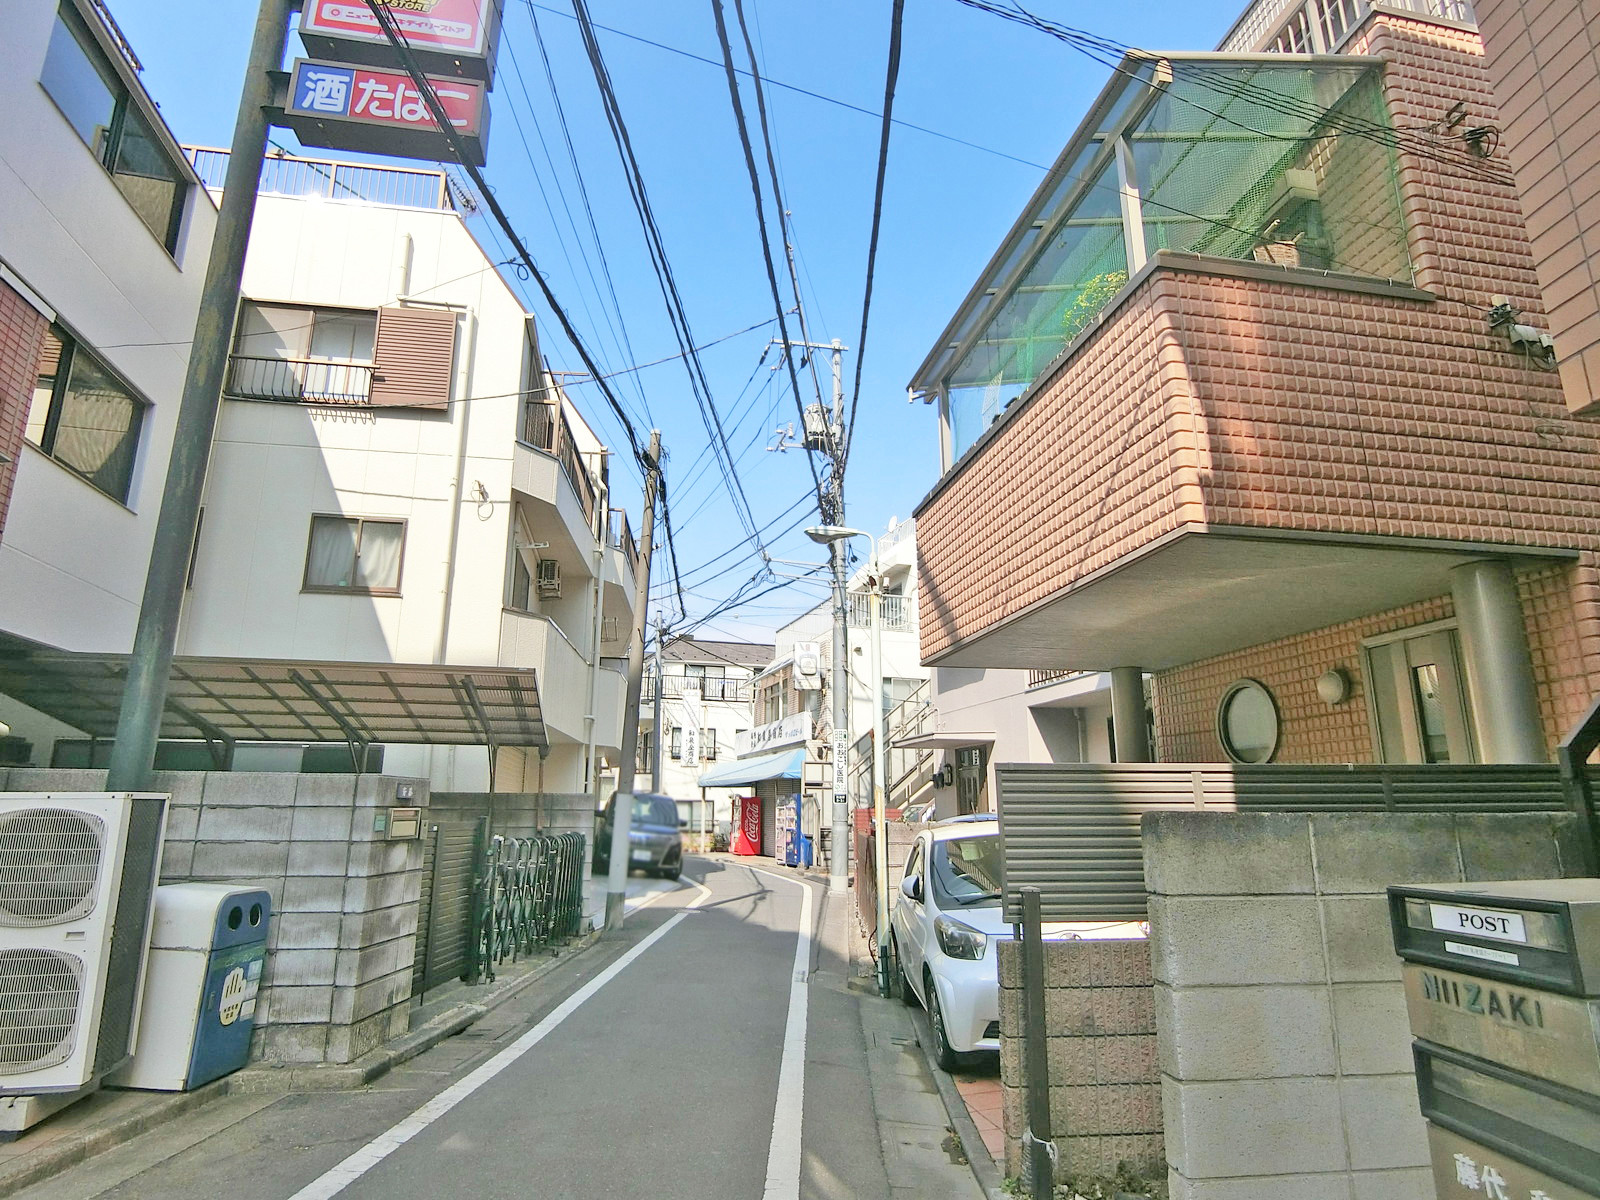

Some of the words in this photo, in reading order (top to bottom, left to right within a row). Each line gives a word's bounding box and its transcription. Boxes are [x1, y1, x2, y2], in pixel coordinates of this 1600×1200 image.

[390, 0, 430, 12] STORE
[301, 70, 351, 112] 酒
[355, 78, 470, 127] たばこ
[836, 743, 844, 784] おおこし医院
[1458, 912, 1511, 935] POST
[1422, 973, 1544, 1028] NIIZAKI
